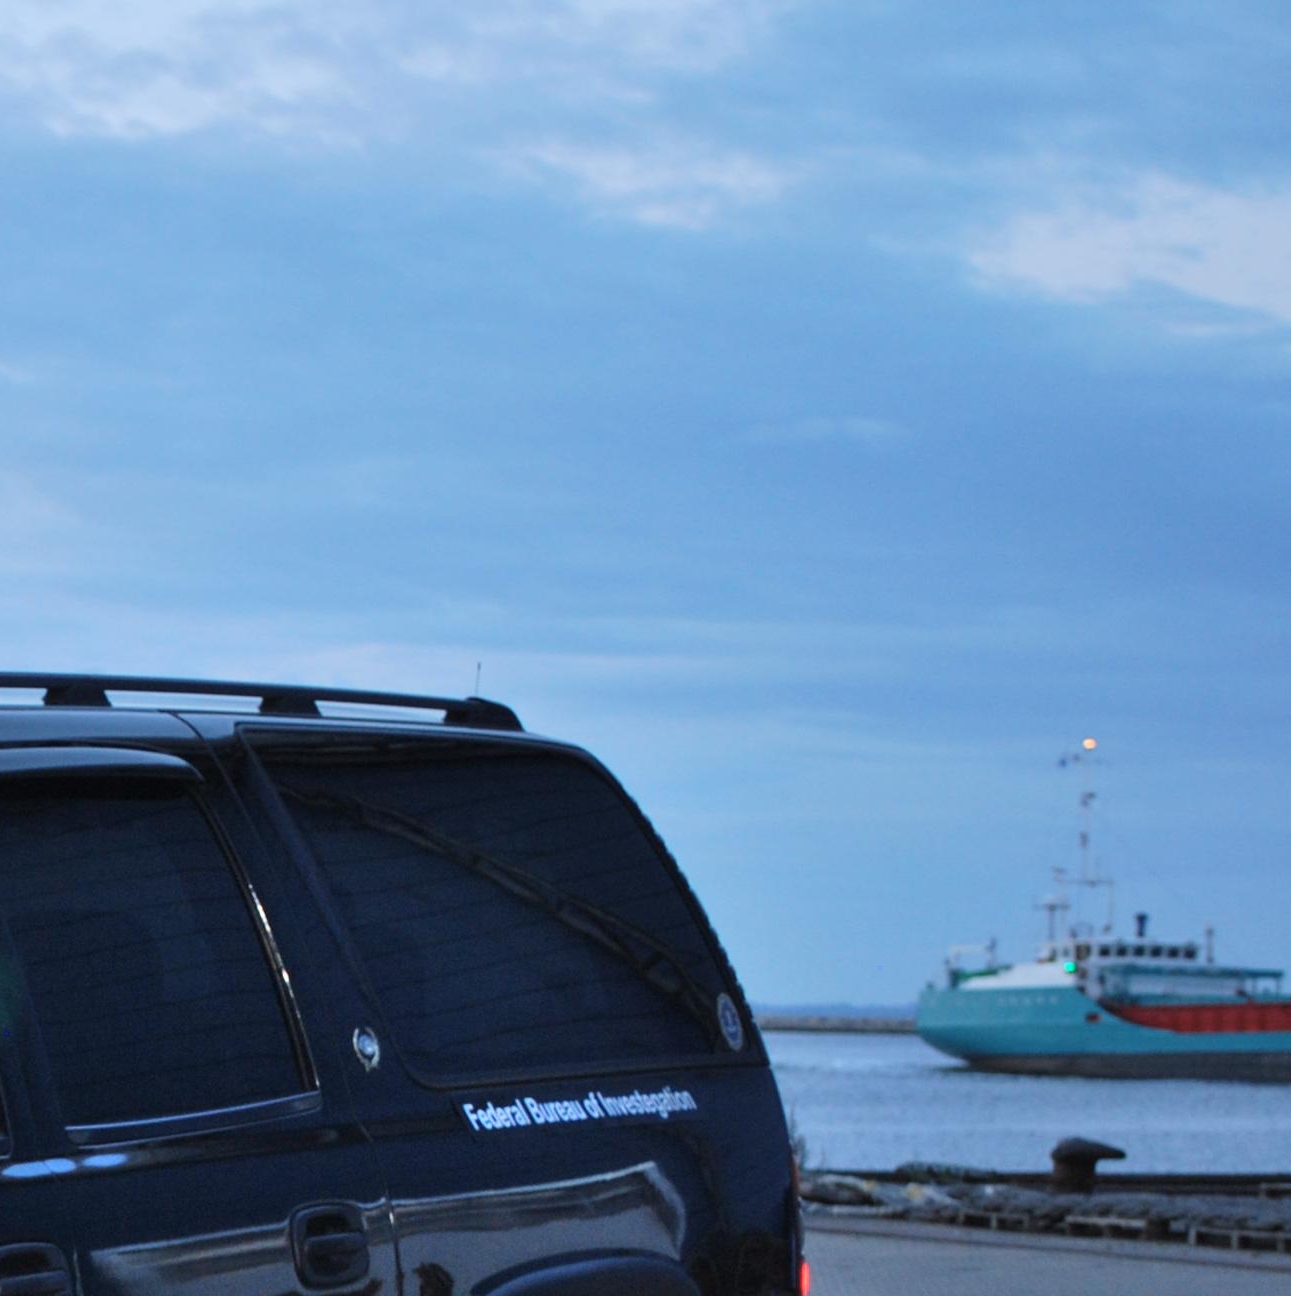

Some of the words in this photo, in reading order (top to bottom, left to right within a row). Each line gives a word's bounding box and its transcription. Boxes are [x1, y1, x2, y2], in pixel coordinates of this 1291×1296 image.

[463, 1099, 531, 1131] Federal
[524, 1097, 587, 1124] Bureau
[583, 1091, 604, 1118] of
